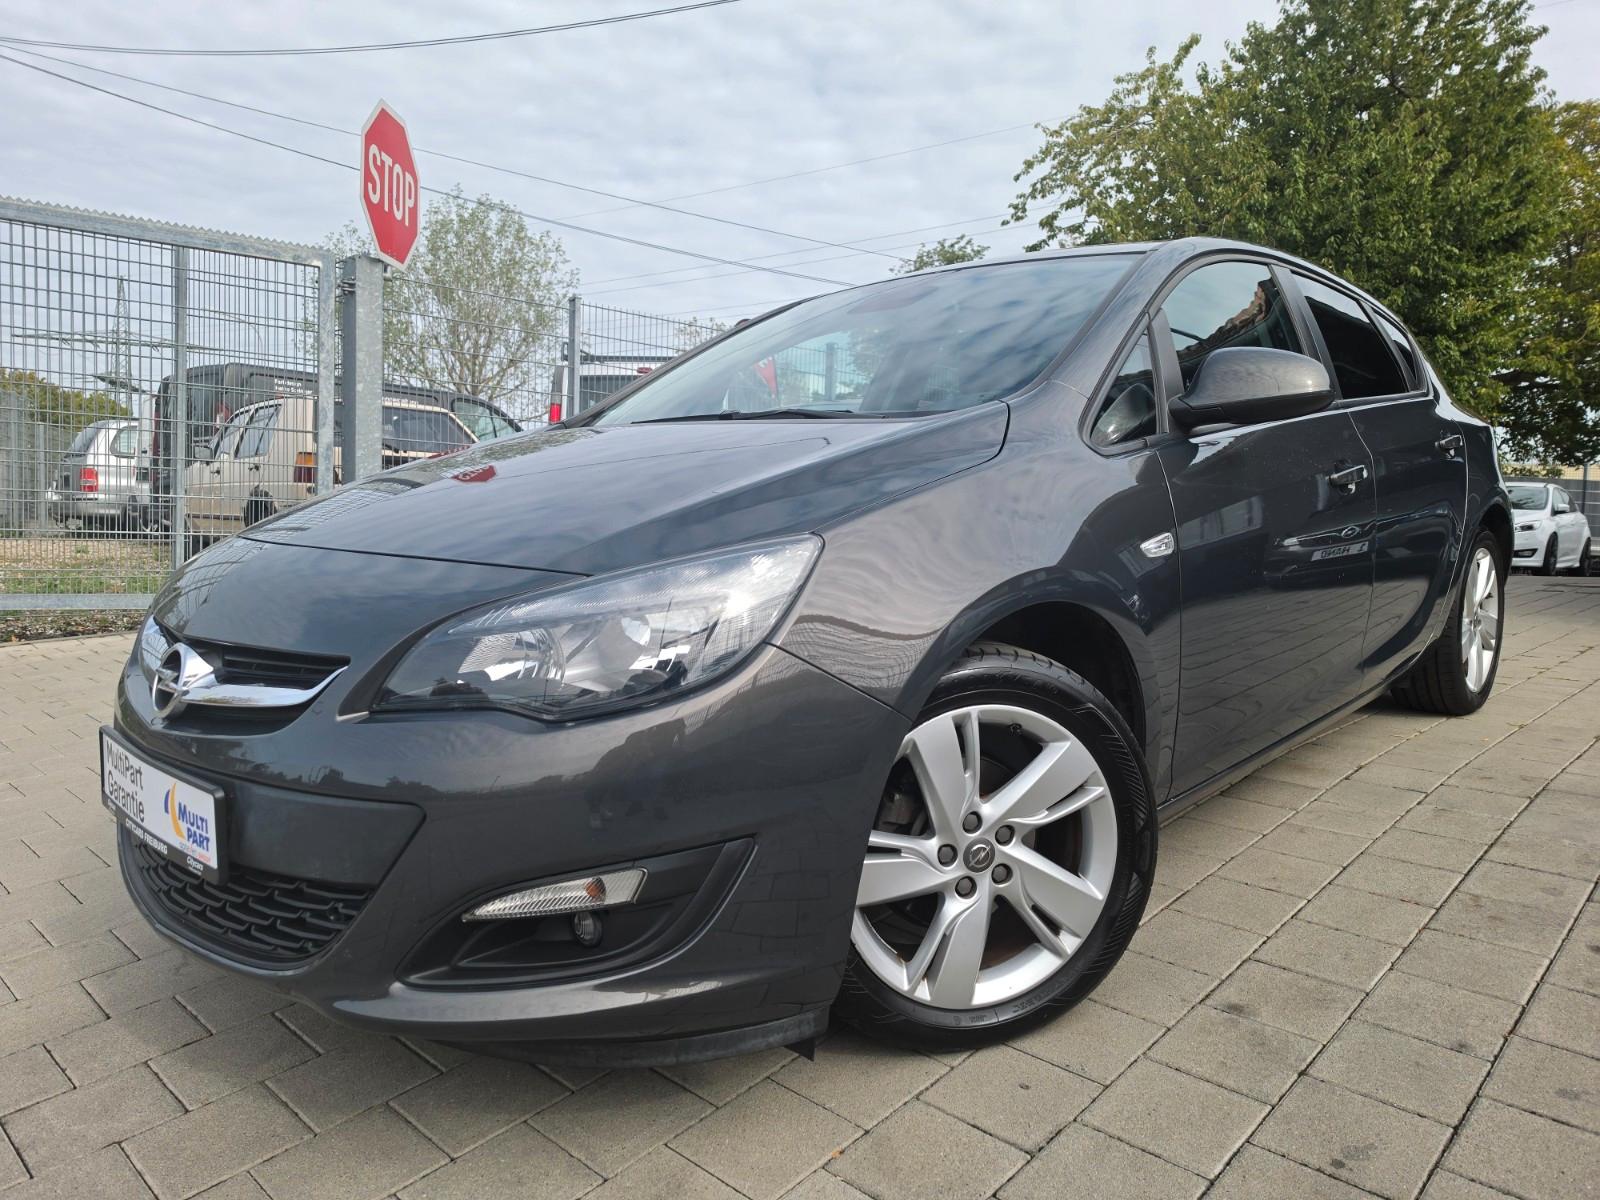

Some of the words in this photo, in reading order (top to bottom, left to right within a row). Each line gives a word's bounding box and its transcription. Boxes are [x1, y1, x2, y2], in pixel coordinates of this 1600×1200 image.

[368, 144, 415, 227] STOP
[106, 739, 143, 791] MultiPart
[107, 770, 145, 823] Garantie
[178, 802, 209, 834] MULTI
[187, 829, 210, 852] PART
